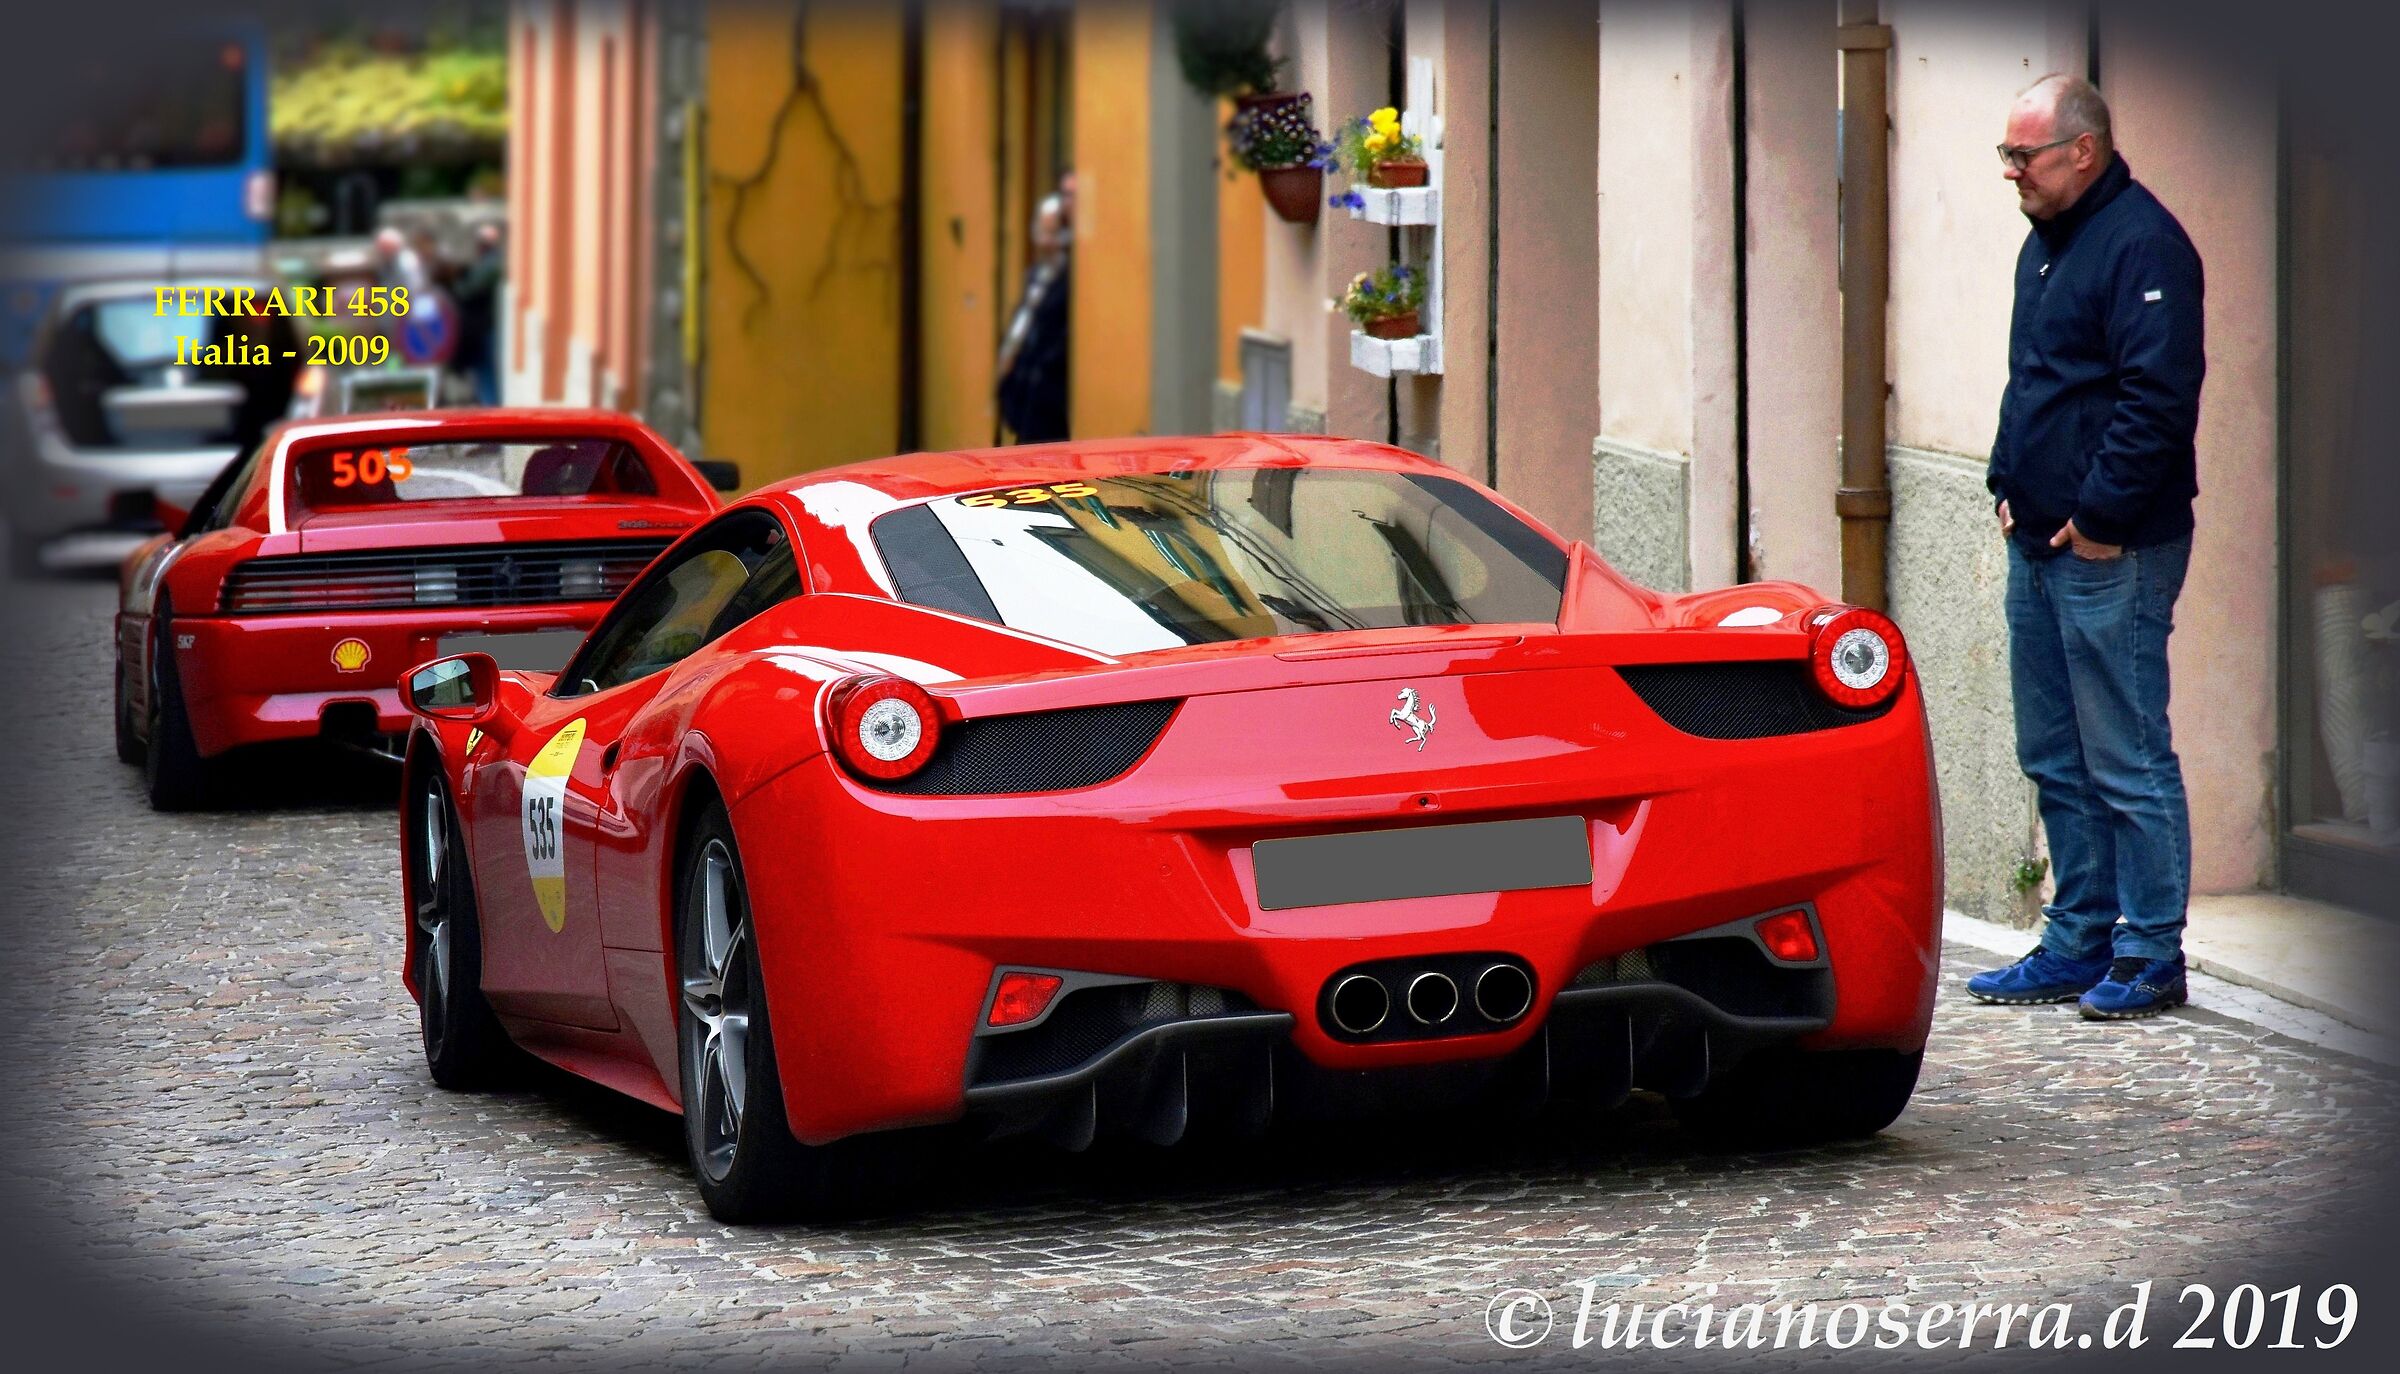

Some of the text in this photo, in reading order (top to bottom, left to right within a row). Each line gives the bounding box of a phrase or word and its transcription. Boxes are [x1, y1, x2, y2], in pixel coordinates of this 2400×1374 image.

[333, 447, 414, 487] 505
[961, 482, 1098, 509] 535
[529, 796, 556, 861] 535
